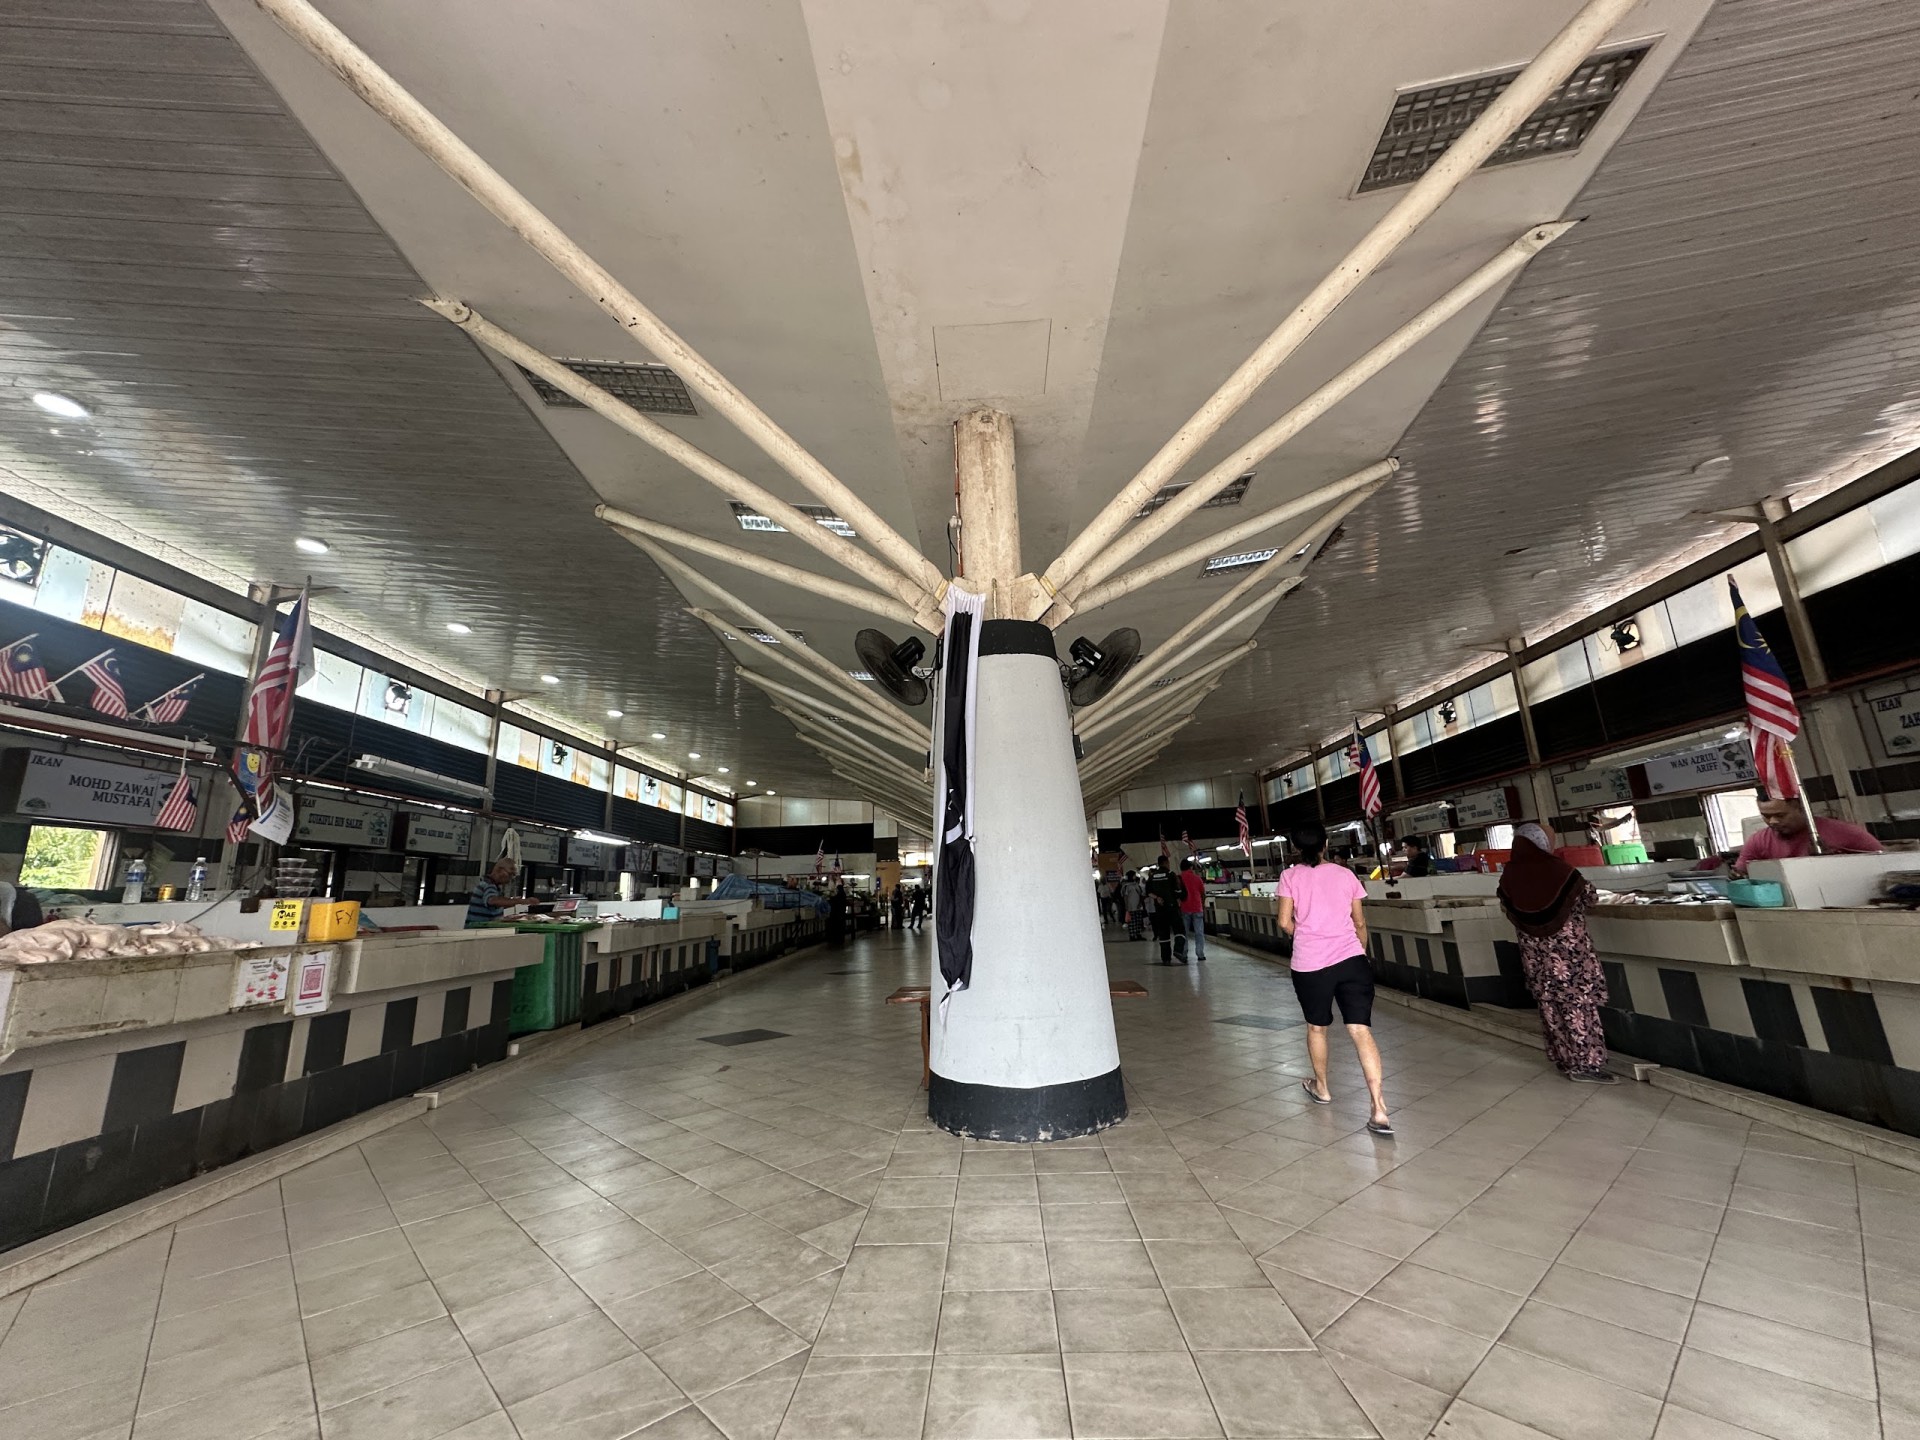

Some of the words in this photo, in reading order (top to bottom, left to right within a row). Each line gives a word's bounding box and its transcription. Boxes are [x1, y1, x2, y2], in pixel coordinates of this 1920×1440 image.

[1877, 696, 1902, 712] IKAN
[30, 754, 62, 767] IKAN
[1670, 758, 1688, 768] WAN
[1690, 752, 1716, 764] AZRUL
[1695, 762, 1718, 773] ARIFF
[69, 774, 112, 790] MOHD
[92, 790, 150, 808] MUSTAFA
[277, 909, 296, 919] MAE
